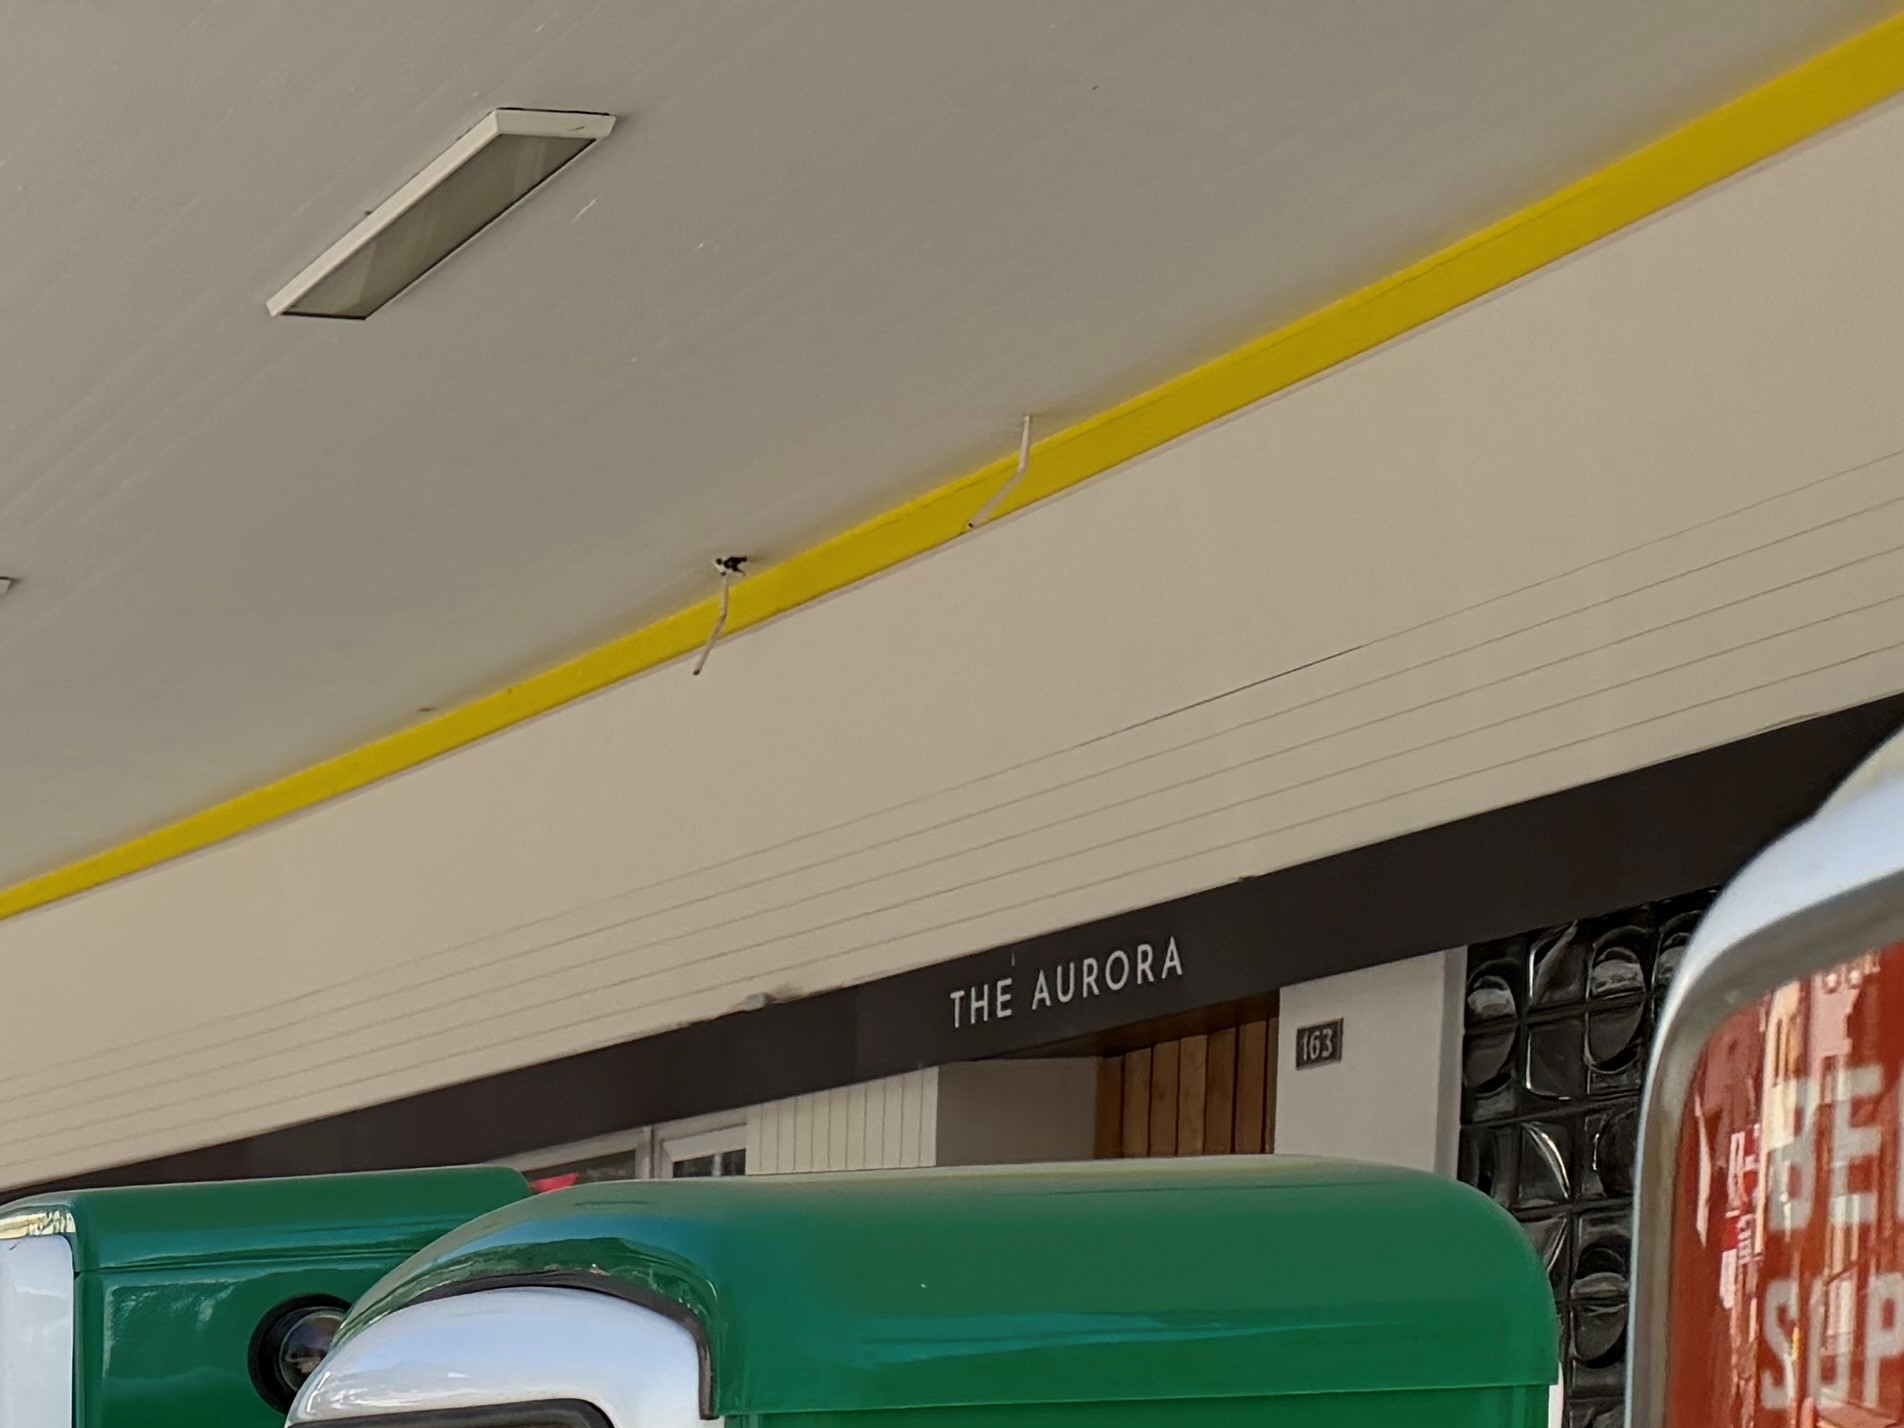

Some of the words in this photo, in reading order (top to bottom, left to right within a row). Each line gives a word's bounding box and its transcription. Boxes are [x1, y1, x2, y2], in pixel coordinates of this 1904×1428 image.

[949, 976, 1013, 1029] THE
[1030, 935, 1184, 1011] AURORA
[1299, 1028, 1334, 1061] 163
[1770, 1057, 1904, 1232] BE
